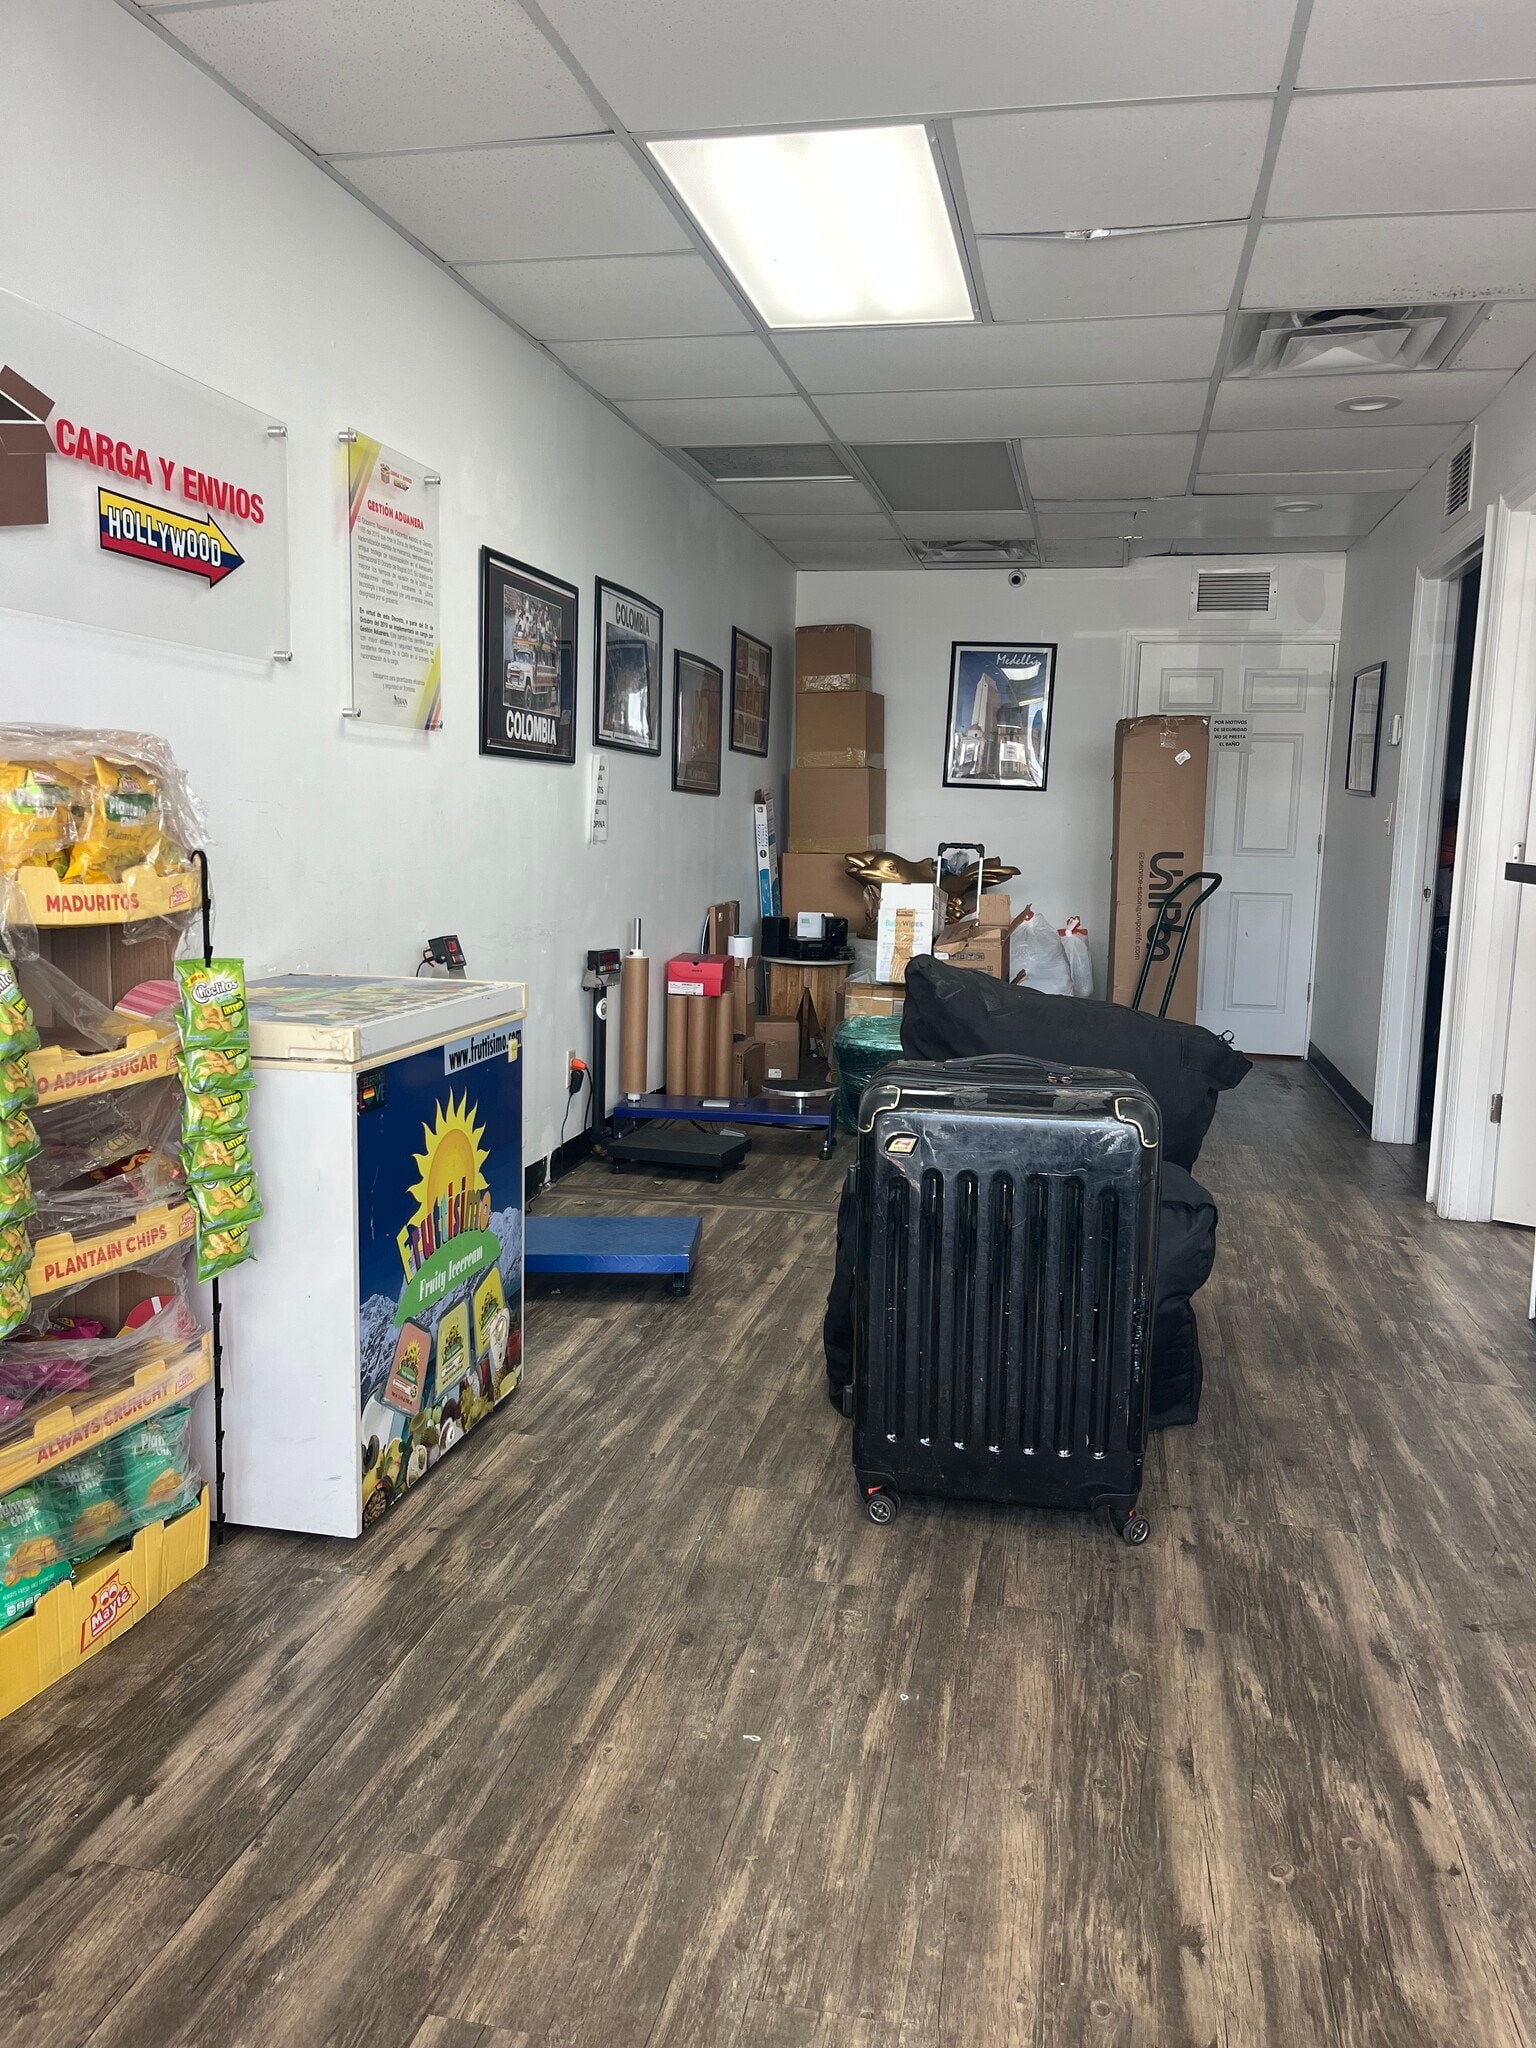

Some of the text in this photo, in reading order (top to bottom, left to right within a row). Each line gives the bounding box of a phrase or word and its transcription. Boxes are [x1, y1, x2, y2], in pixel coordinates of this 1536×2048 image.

[56, 418, 264, 525] CARGA Y ENVIOS
[367, 499, 425, 531] GESTIÓN ADUANERA
[107, 505, 222, 568] HOLLYWOOD
[615, 601, 650, 638] COLOMBIA
[506, 709, 557, 746] COLOMBIA
[46, 893, 140, 913] MADURITOS
[903, 919, 924, 929] Wipes
[192, 979, 239, 1004] Choclitos
[449, 1030, 522, 1071] www.fruttisimo.com
[53, 1066, 109, 1092] ADDED
[111, 1053, 158, 1079] SUGAR
[396, 1176, 492, 1285] Fruttisimo
[44, 1224, 168, 1282] PLANTAIN CHIPS
[419, 1245, 484, 1302] Fruity Icecream
[36, 1382, 169, 1464] ALWAYS CRUNCHY
